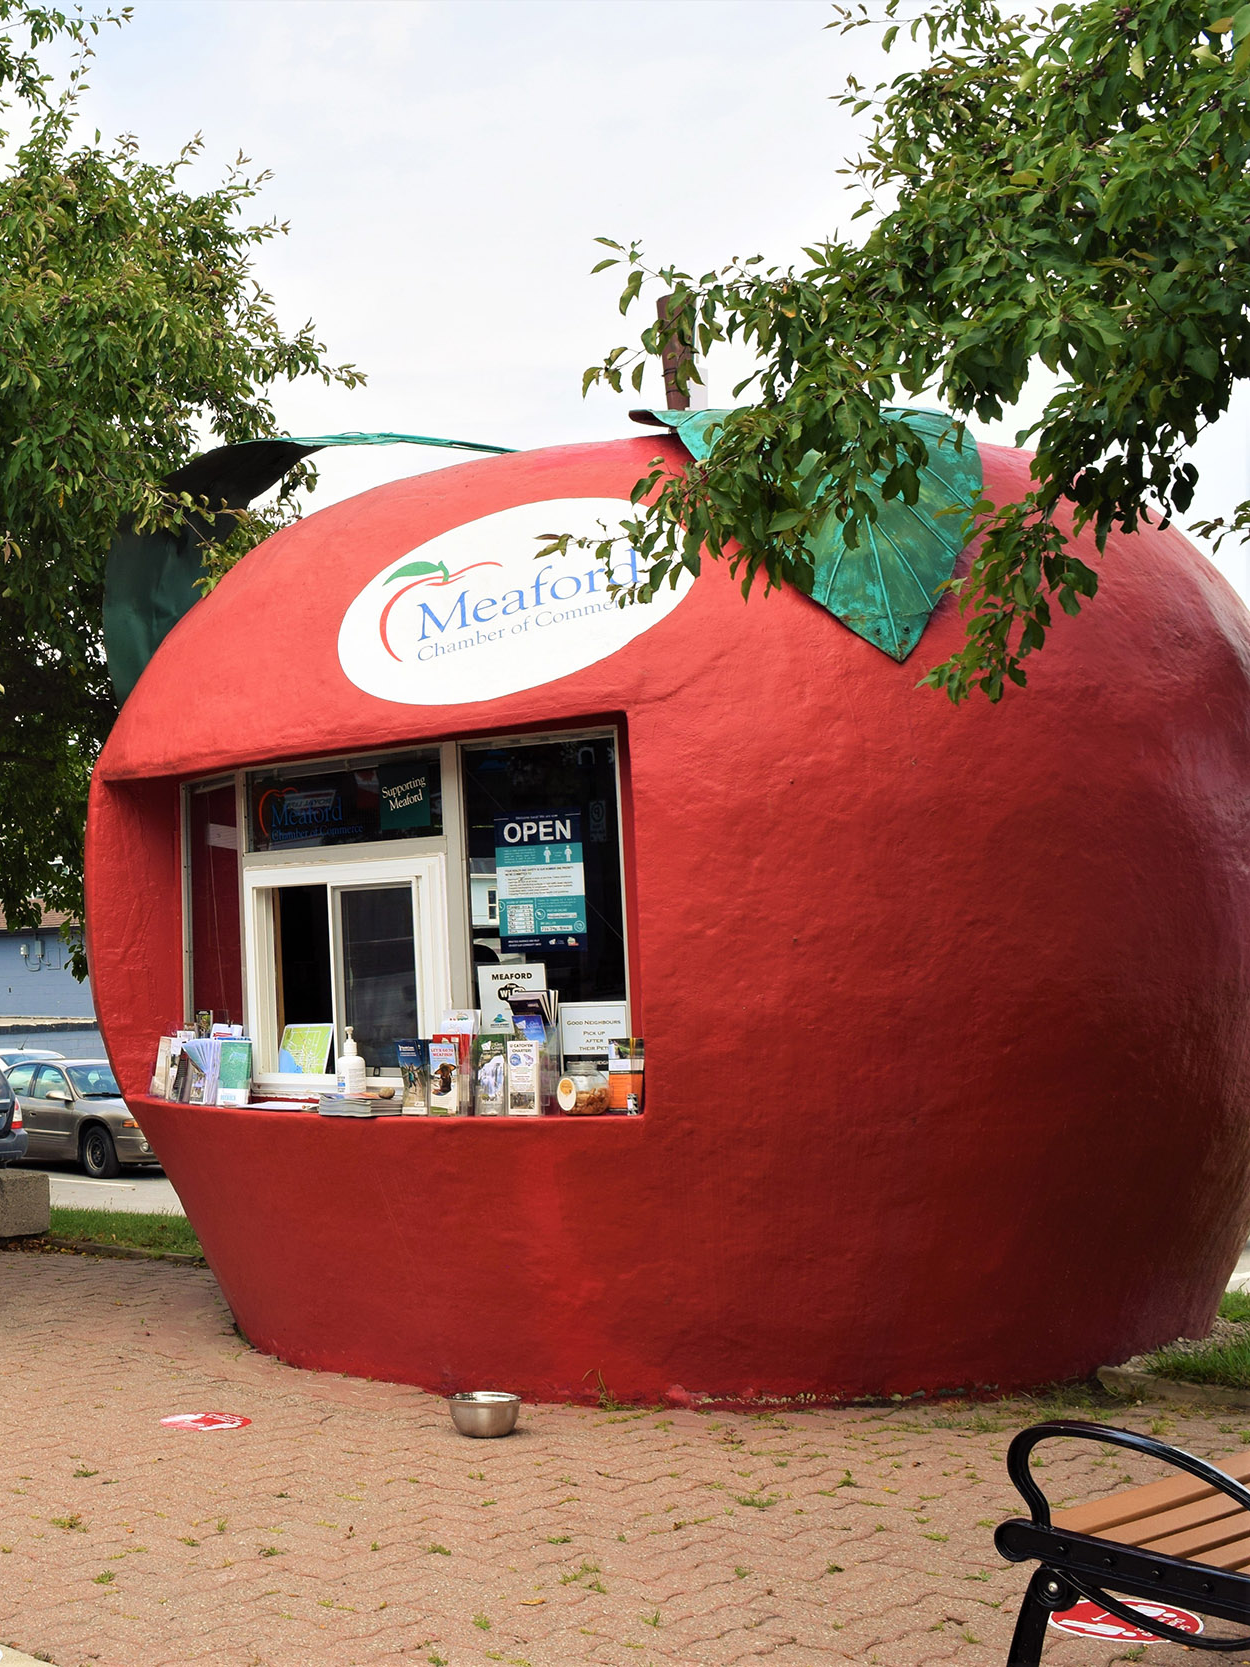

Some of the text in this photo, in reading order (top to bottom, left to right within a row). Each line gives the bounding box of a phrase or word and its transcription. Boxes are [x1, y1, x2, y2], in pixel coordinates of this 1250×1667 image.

[417, 548, 642, 641] Meaford
[417, 627, 506, 661] Chamber
[511, 616, 531, 635] of
[381, 776, 427, 799] Supporting
[388, 788, 424, 811] Meaford
[271, 797, 343, 827] Meaford
[271, 828, 309, 841] Chamber
[320, 824, 364, 837] Commerce
[503, 819, 572, 843] OPEN
[491, 972, 533, 981] MEAFORD
